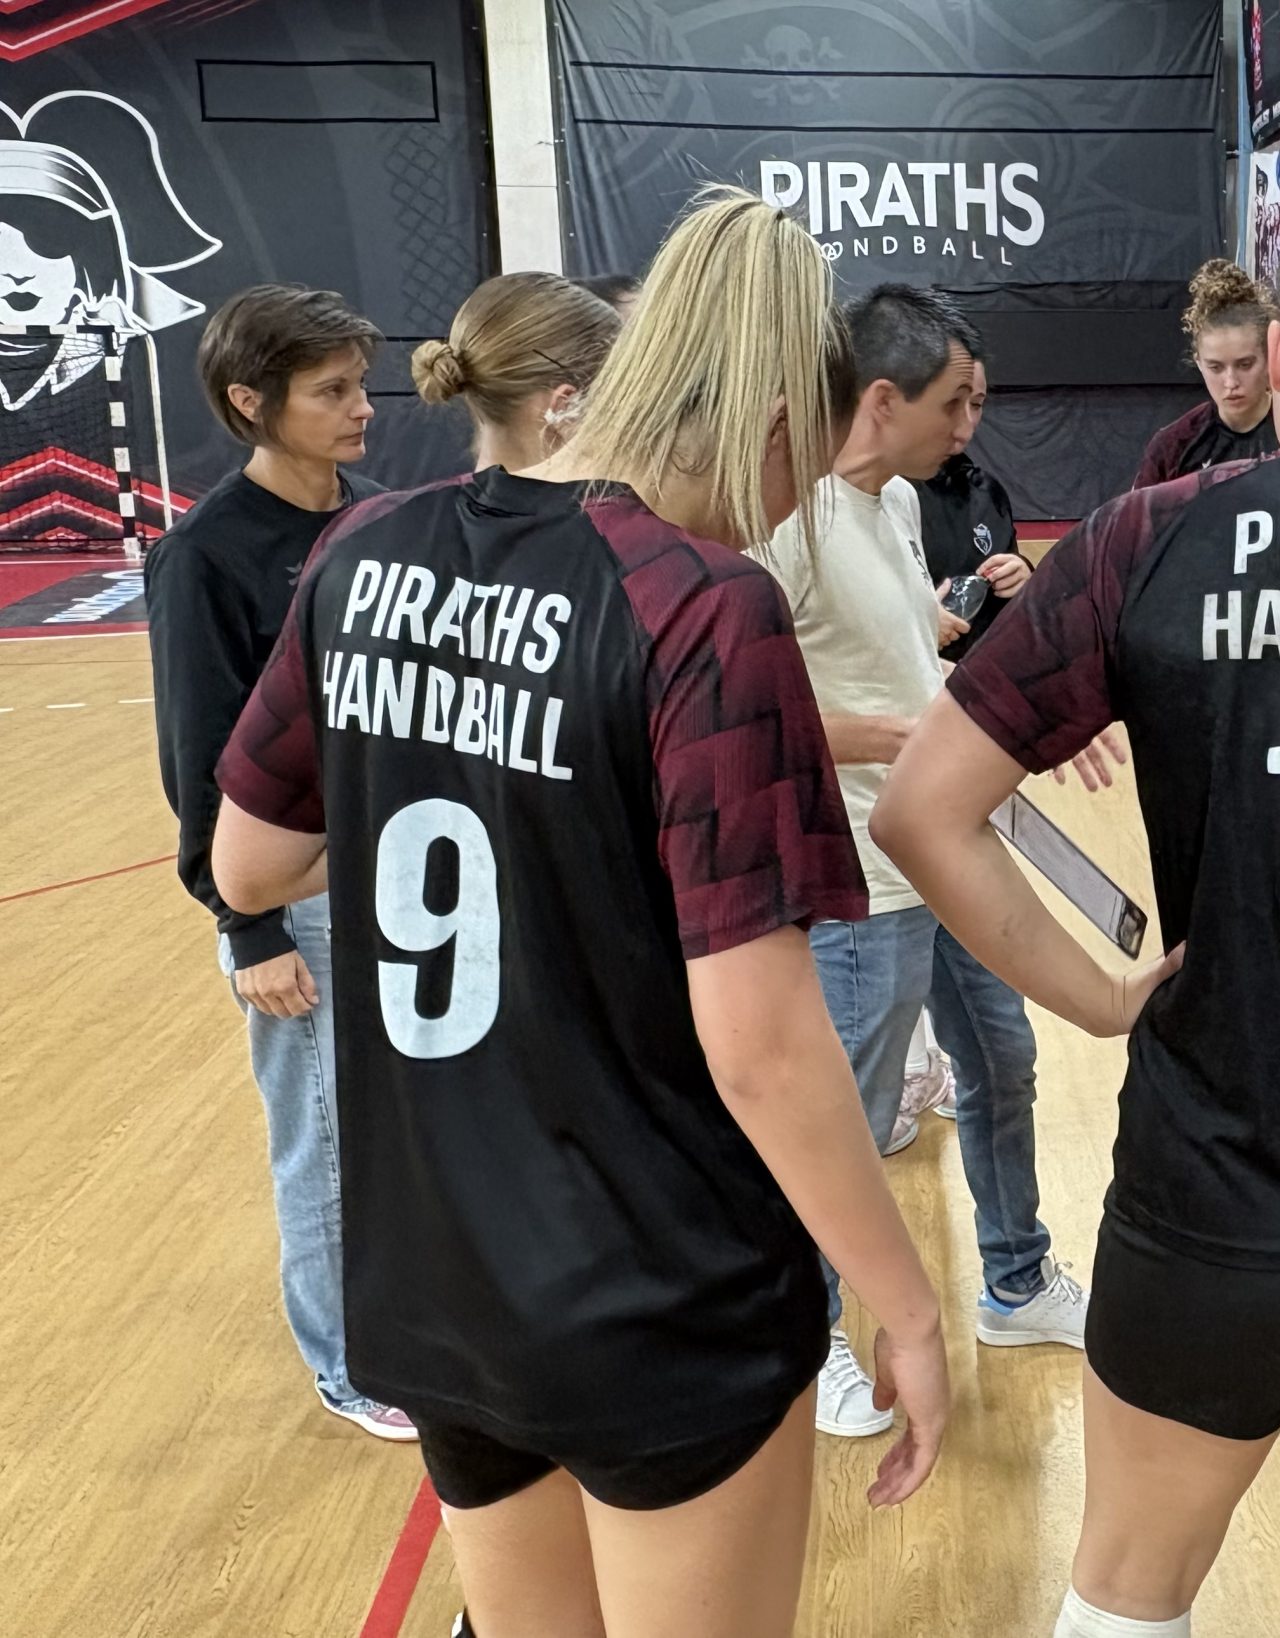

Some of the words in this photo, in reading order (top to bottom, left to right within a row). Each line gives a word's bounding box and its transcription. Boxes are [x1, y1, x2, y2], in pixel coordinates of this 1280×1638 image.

[760, 161, 1045, 246] PIRATHS
[342, 559, 572, 674] PIRATHS
[323, 650, 573, 781] HANDBALL
[375, 798, 500, 1060] 9
